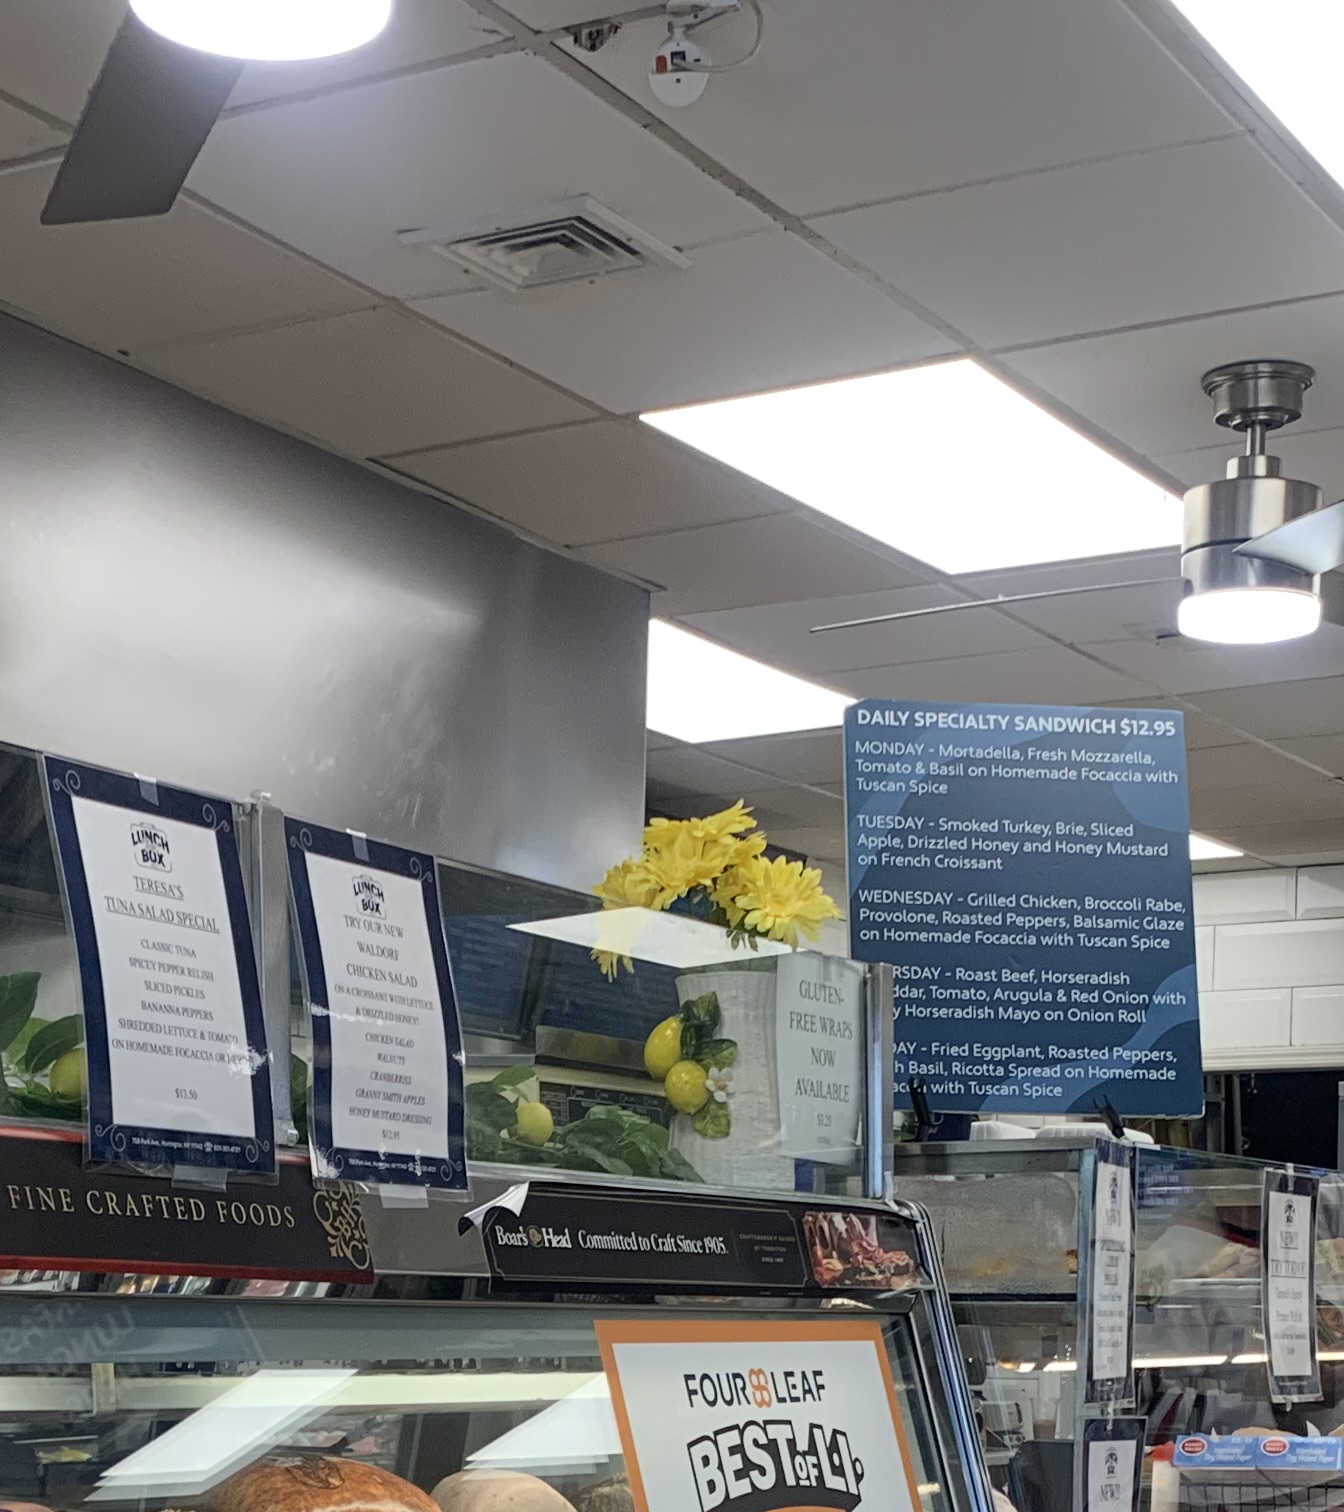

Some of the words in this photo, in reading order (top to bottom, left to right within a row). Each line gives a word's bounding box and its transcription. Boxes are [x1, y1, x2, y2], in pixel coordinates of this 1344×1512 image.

[857, 709, 910, 728] DAILY
[914, 712, 1009, 731] SPECIALTY
[1014, 716, 1116, 734] SANDWICH
[1120, 717, 1175, 737] $12.95
[855, 759, 911, 775] Tomato
[915, 762, 925, 774] &
[929, 762, 964, 777] Basil
[968, 767, 988, 778] on
[991, 765, 1077, 781] Homemade
[1081, 768, 1142, 783] Focaccia
[1145, 770, 1178, 784] with
[856, 778, 906, 793] Tuscan
[909, 780, 948, 796] Spice
[131, 829, 170, 854] LUNCH
[857, 835, 904, 851] Apple,
[908, 836, 968, 851] Drizzled
[971, 838, 1019, 855] Honey
[1023, 839, 1051, 852] and
[1055, 840, 1103, 858] Honey
[1107, 841, 1168, 857] Mustard
[142, 849, 165, 868] BOX
[133, 876, 184, 900] TERESA'S
[353, 881, 385, 903] LUNCH
[104, 896, 137, 916] TUNA
[139, 904, 175, 923] SALAD
[176, 912, 220, 932] SPECIAL
[362, 898, 381, 915] BOX
[357, 941, 399, 961] WALDORF
[346, 963, 387, 981] CHICKEN
[388, 972, 417, 988] SALAD
[798, 979, 845, 1006] GLUTEN-
[789, 1010, 816, 1033] FREE
[819, 1015, 853, 1041] WRAPS
[811, 1047, 836, 1068] NOW
[175, 1088, 197, 1100] $13.50
[794, 1078, 850, 1103] AVAILABLE
[7, 1184, 75, 1214] FINE
[86, 1190, 207, 1224] CRAFTED
[215, 1201, 296, 1229] FOODS
[495, 1225, 528, 1248] Boar's
[541, 1227, 571, 1250] Head
[578, 1228, 638, 1252] Committed
[639, 1234, 650, 1252] to
[651, 1232, 676, 1253] Craft
[677, 1233, 703, 1254] Since
[683, 1372, 751, 1408] FOUR
[770, 1370, 826, 1404] LEAF
